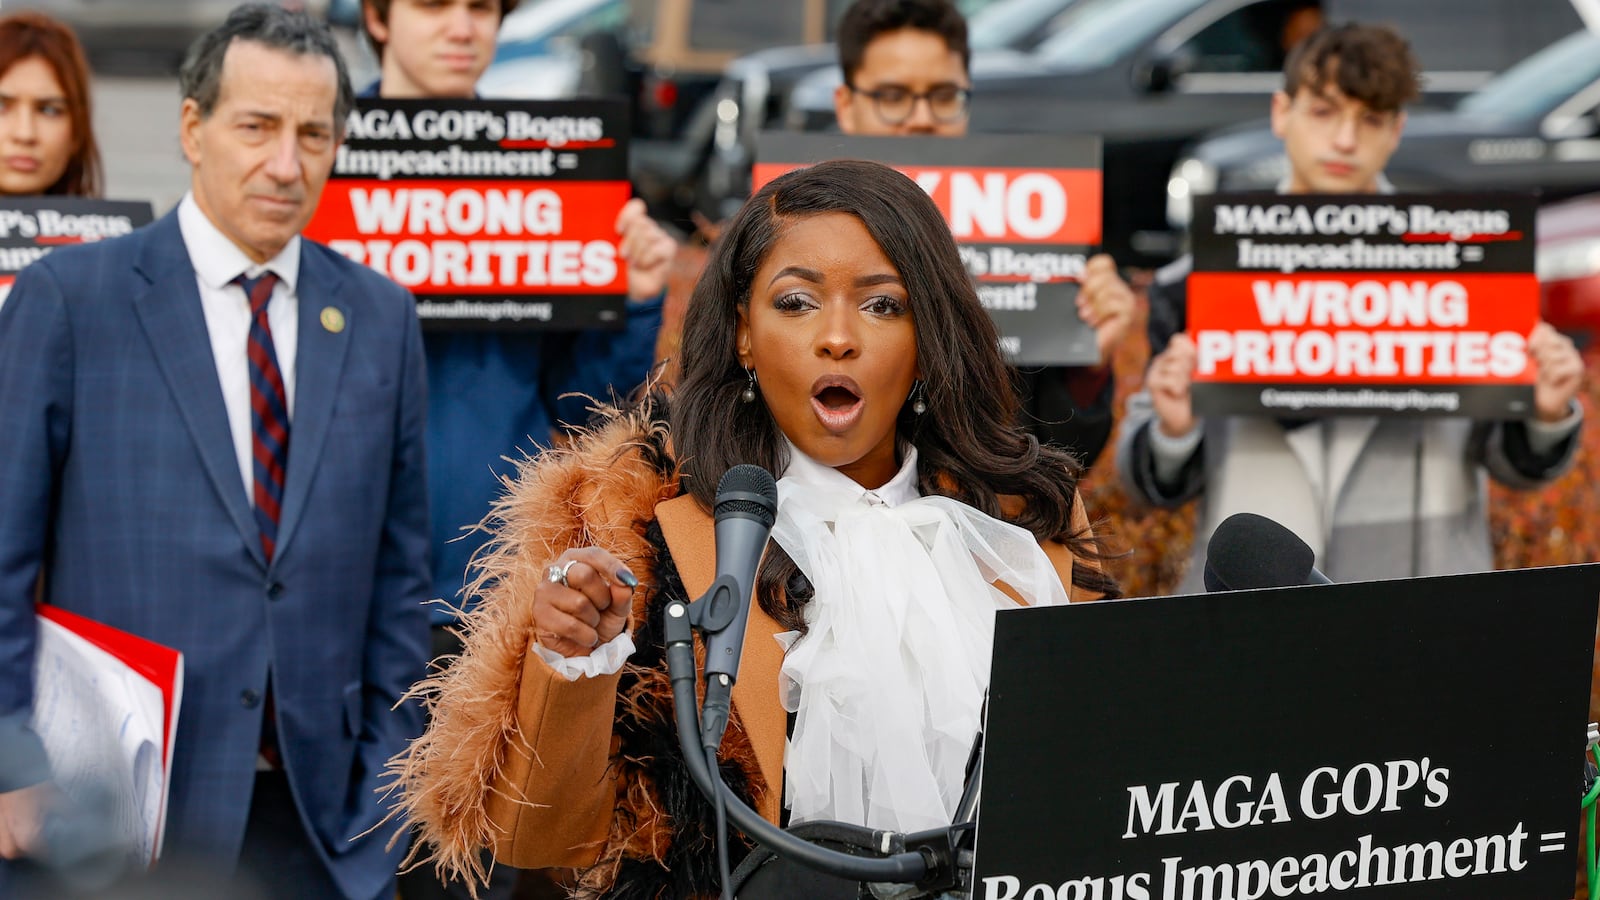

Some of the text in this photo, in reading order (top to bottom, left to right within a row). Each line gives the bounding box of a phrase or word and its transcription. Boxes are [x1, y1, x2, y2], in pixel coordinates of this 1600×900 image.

[346, 110, 603, 147] AGA GOP's Bogus
[335, 145, 556, 179] Impeachment
[38, 209, 134, 242] Bogus
[349, 188, 563, 235] WRONG
[951, 171, 1067, 239] NO
[1214, 205, 1510, 241] MAGA GOP's Bogus
[332, 240, 618, 286] IORITIES
[1238, 239, 1460, 273] Impeachment
[1252, 280, 1468, 327] WRONG
[1197, 330, 1529, 377] PRIORITIES
[1122, 757, 1450, 839] MAGA GOP's
[1161, 822, 1529, 900] Impeachment
